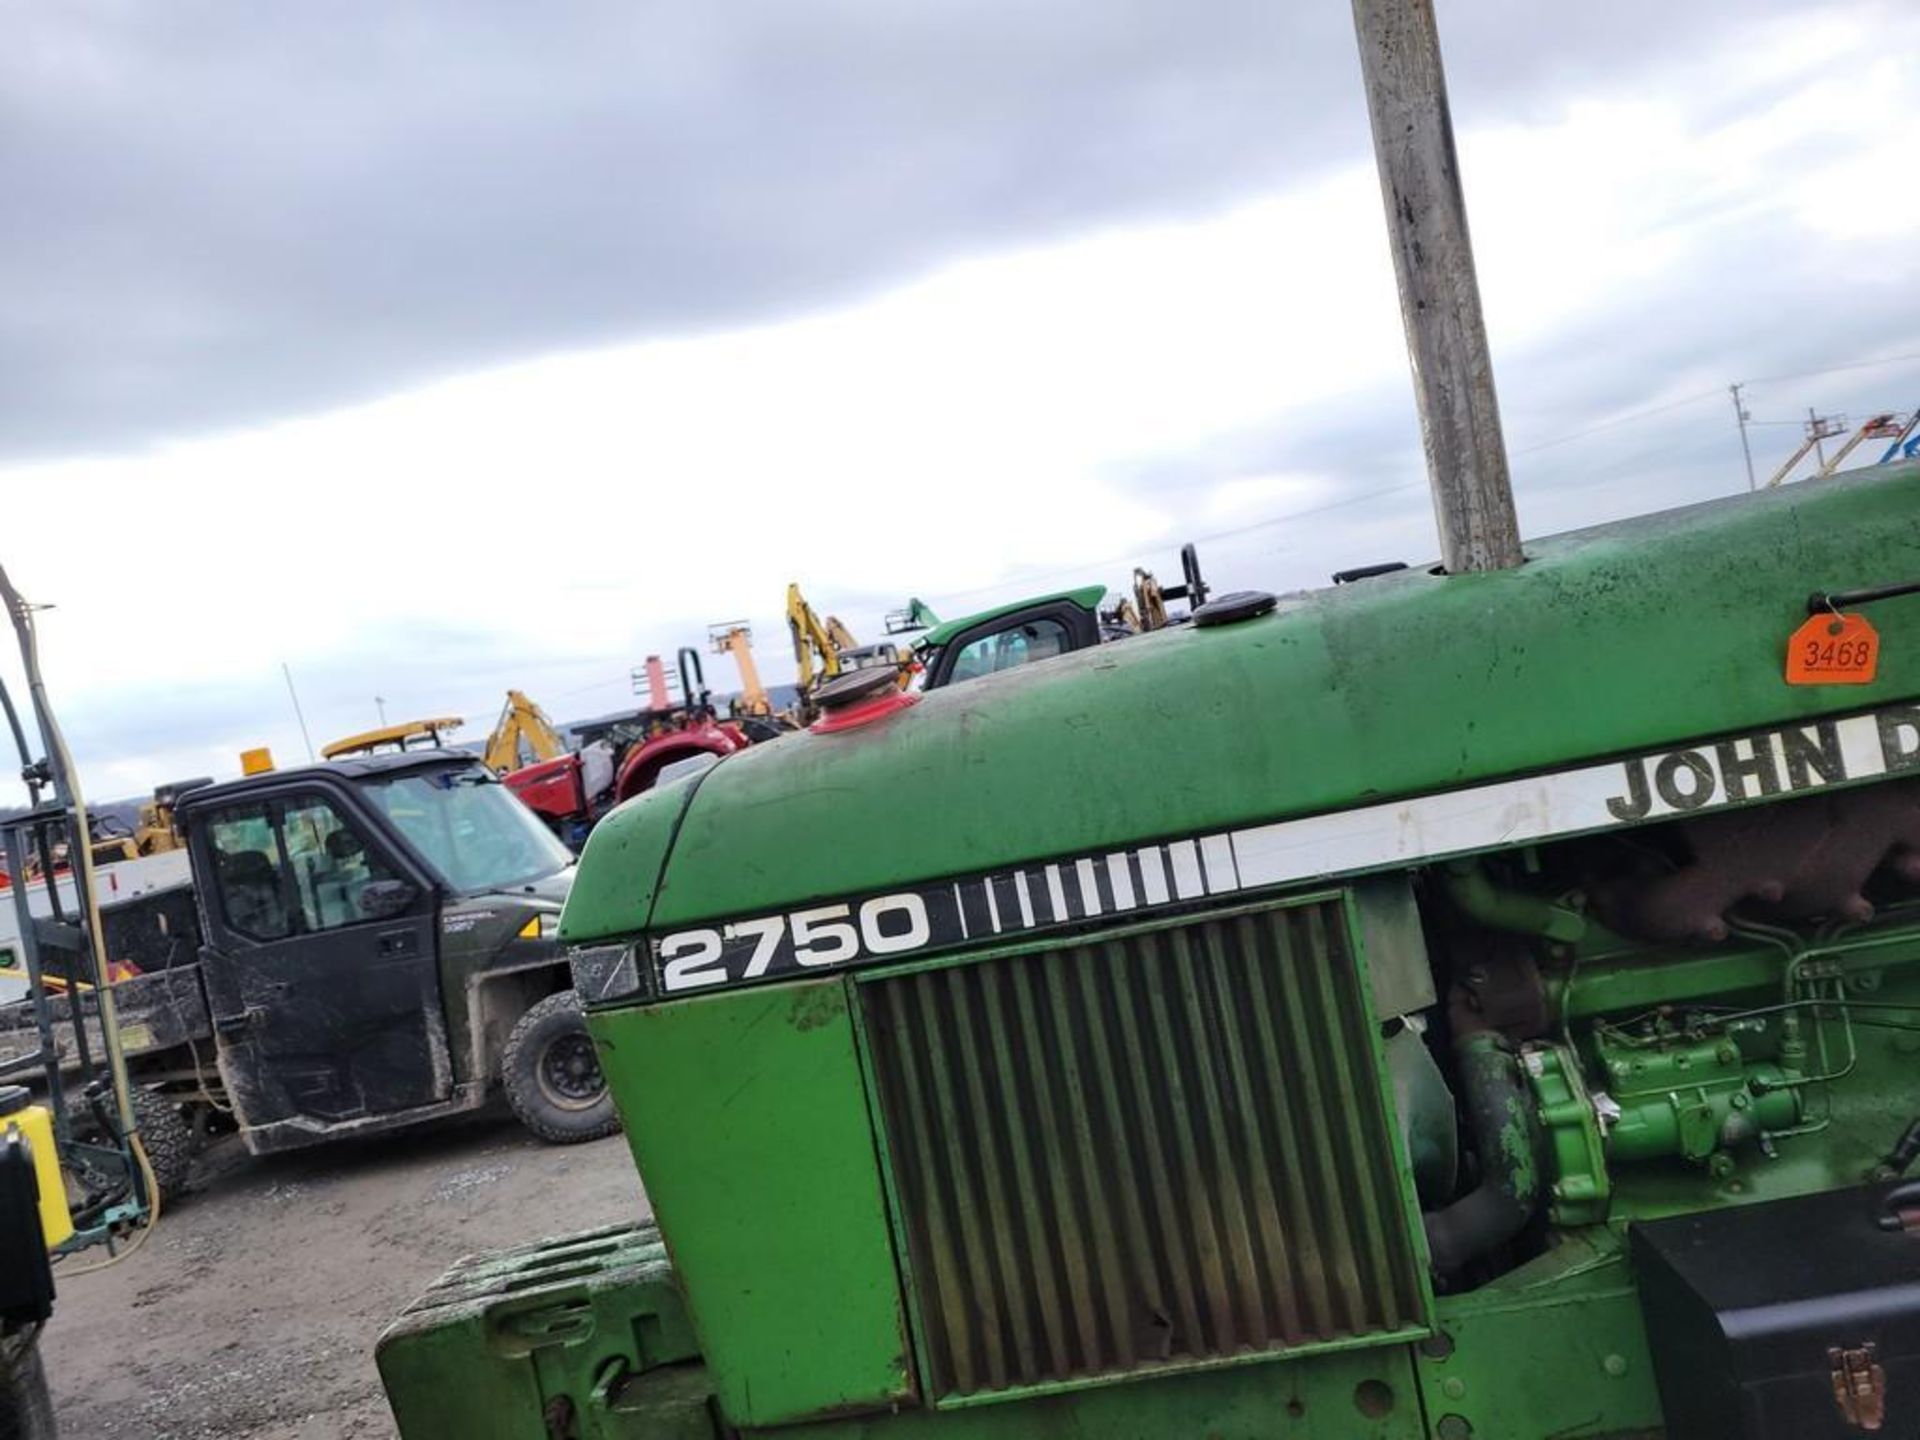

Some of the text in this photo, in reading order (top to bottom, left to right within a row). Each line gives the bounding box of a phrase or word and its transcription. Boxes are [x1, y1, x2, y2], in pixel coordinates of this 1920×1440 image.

[1804, 641, 1869, 667] 3468
[1605, 720, 1848, 822] JOHN
[660, 893, 931, 991] 2750
